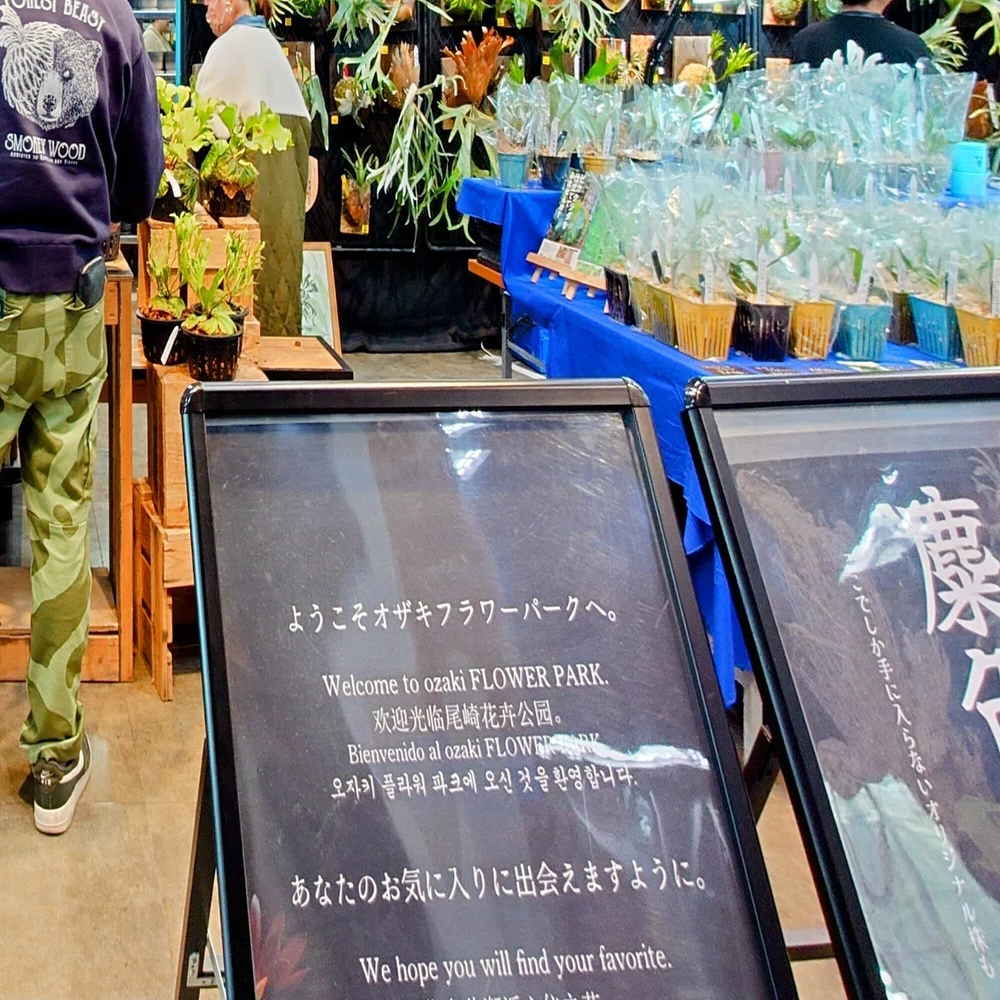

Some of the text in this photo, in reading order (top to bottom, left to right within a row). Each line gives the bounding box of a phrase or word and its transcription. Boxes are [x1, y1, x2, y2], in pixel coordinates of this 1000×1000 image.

[48, 139, 86, 160] WOOD
[288, 595, 616, 634] ようこそオザキフラワーパークへ。
[322, 662, 609, 697] Welcome to ozaki FLOWER PARK.
[372, 699, 562, 734] 欢迎光临尾崎花卉公园。
[347, 740, 423, 765] Bienvenido
[428, 737, 442, 761] al
[445, 737, 482, 760] ozaki
[331, 774, 375, 802] 오자키
[381, 771, 426, 800] 플라워
[432, 768, 477, 796] 파크에
[484, 767, 513, 794] 오신
[291, 857, 706, 907] あなたのお気に入りに出会えますように。
[360, 943, 672, 987] We hope you will find your favorite.
